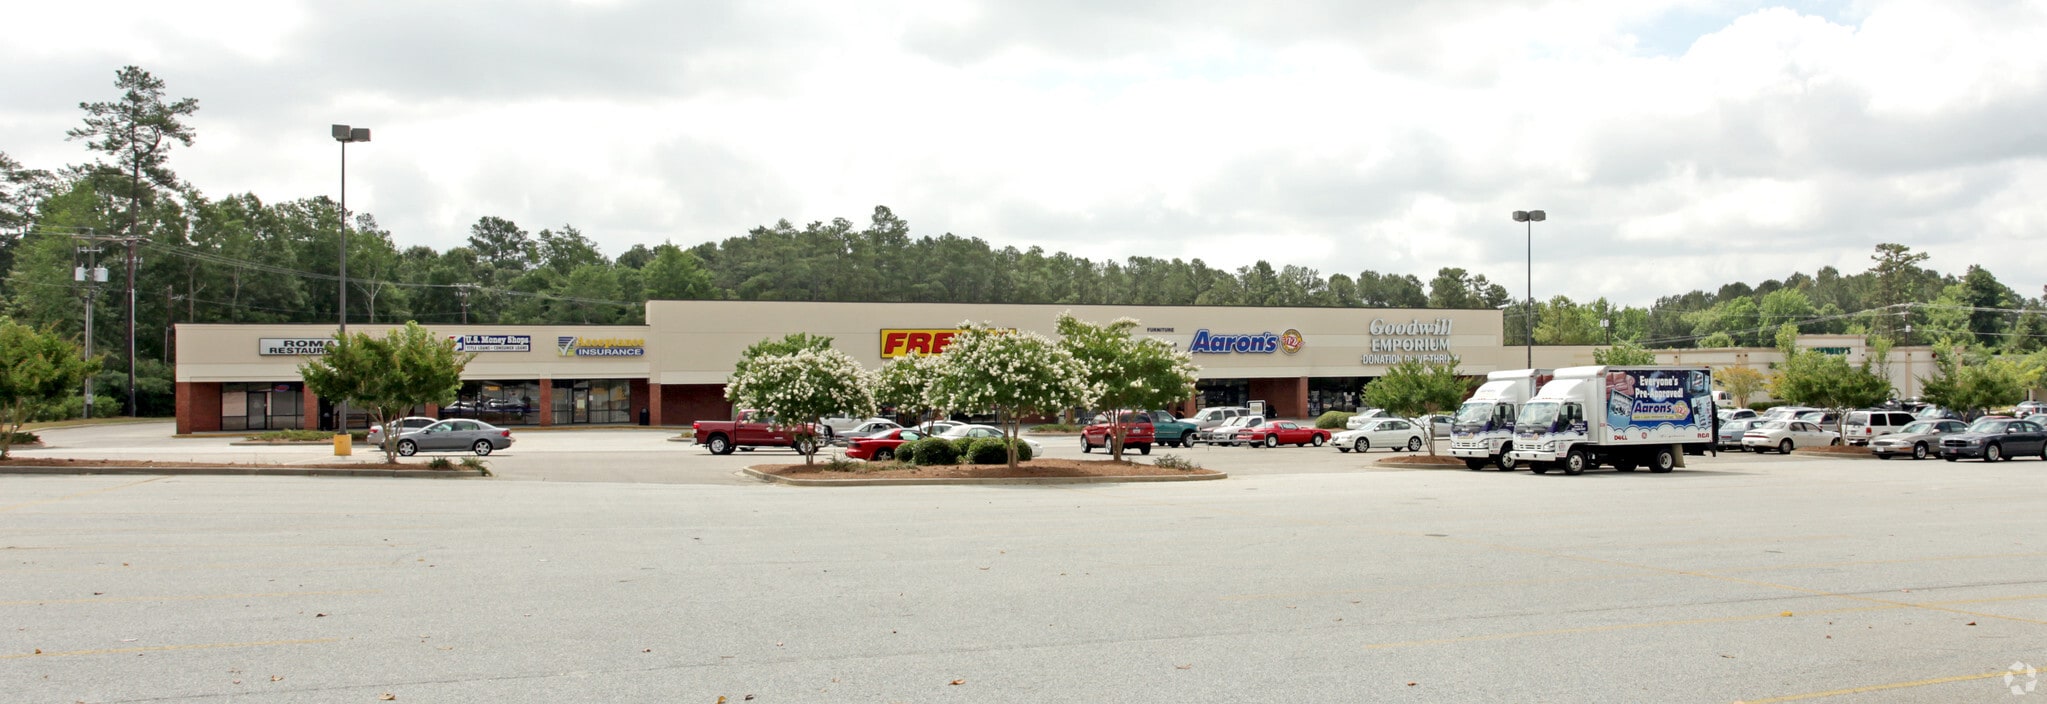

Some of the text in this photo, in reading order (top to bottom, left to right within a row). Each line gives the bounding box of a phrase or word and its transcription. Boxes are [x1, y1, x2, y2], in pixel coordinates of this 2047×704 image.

[1369, 318, 1453, 336] Goodwill
[465, 335, 529, 346] U.S. Money Shops
[1188, 328, 1280, 354] Aaron's
[1371, 338, 1451, 353] EMPORIUM
[578, 348, 642, 356] INSURANCE
[1362, 354, 1401, 365] DONATION
[1639, 375, 1679, 388] Everyone's
[1634, 387, 1684, 399] Pre-Approved!
[1634, 402, 1673, 413] Aaron's
